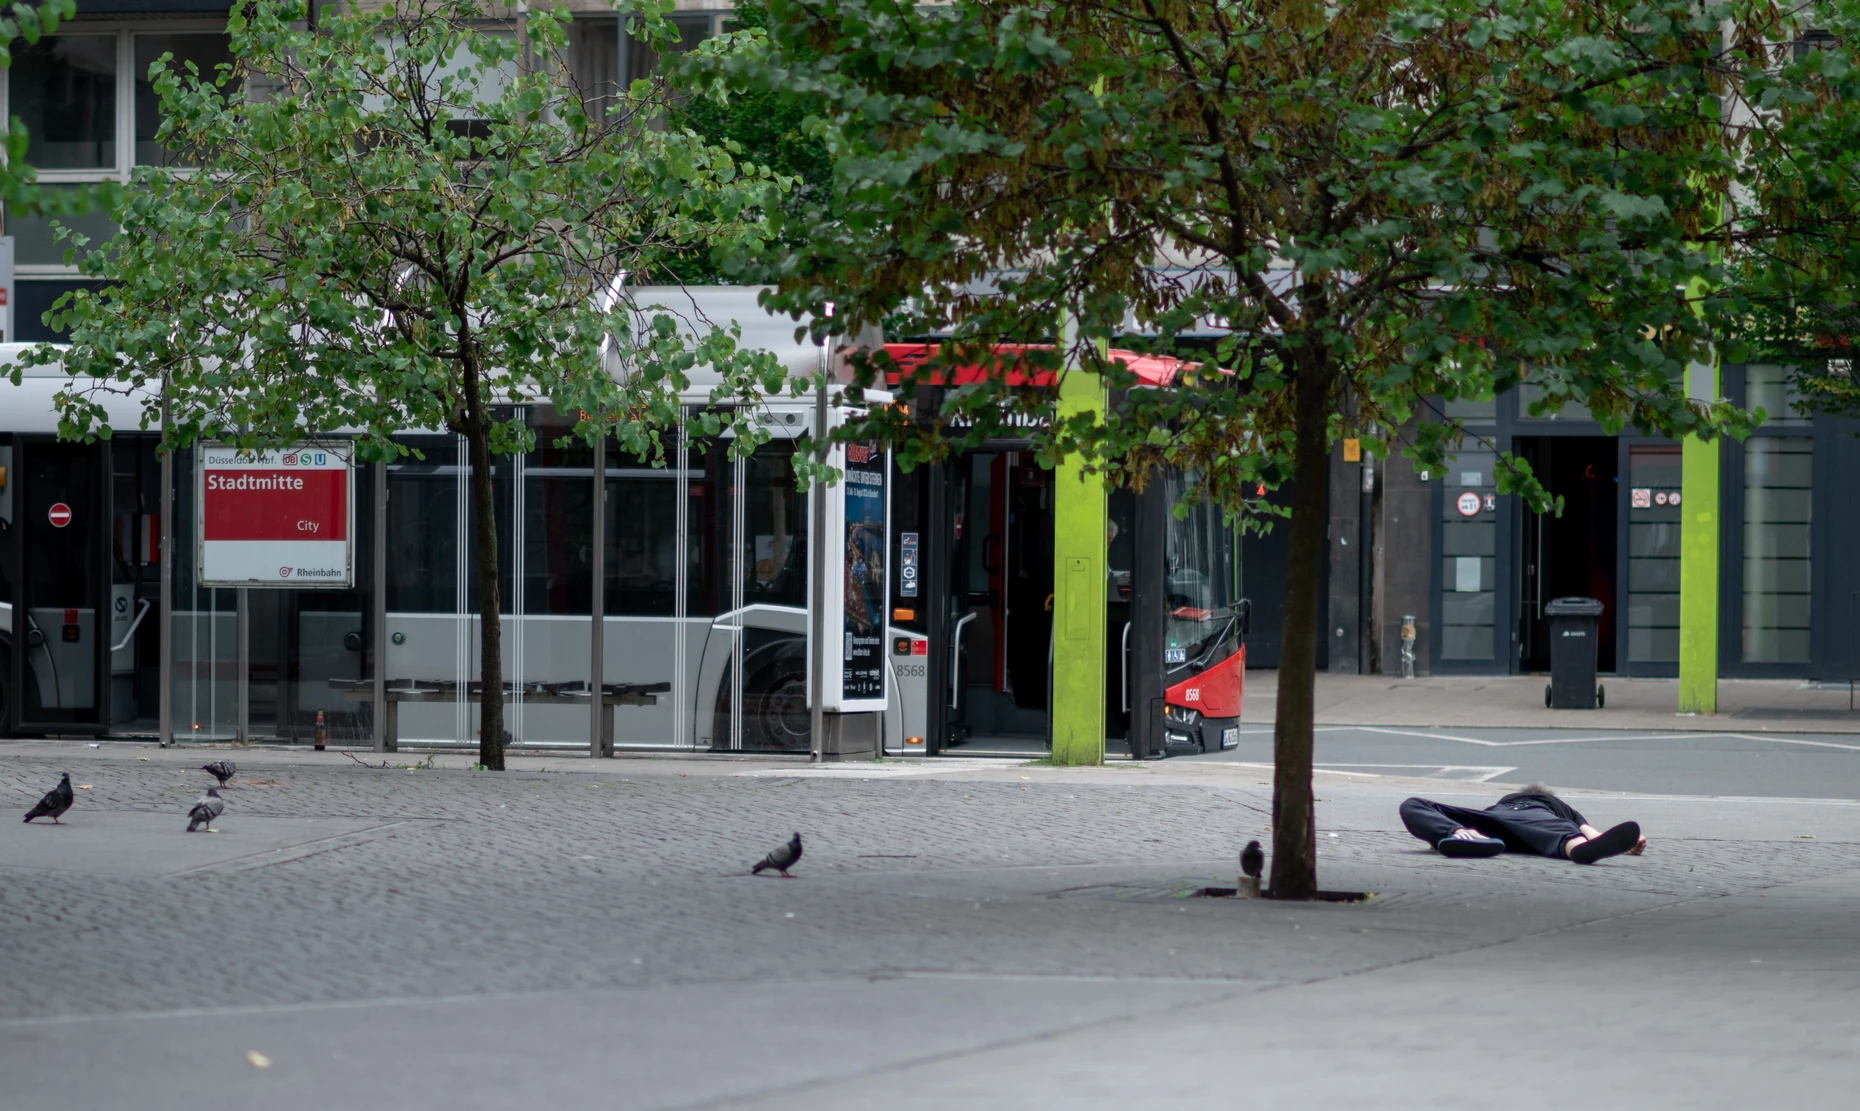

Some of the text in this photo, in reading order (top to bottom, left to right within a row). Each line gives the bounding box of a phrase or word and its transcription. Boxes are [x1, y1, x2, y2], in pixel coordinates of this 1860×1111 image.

[208, 474, 303, 490] Stadtmitte
[297, 520, 320, 533] City
[297, 568, 342, 577] Rheinbahn
[896, 664, 925, 677] 8568
[1185, 688, 1199, 701] 8568
